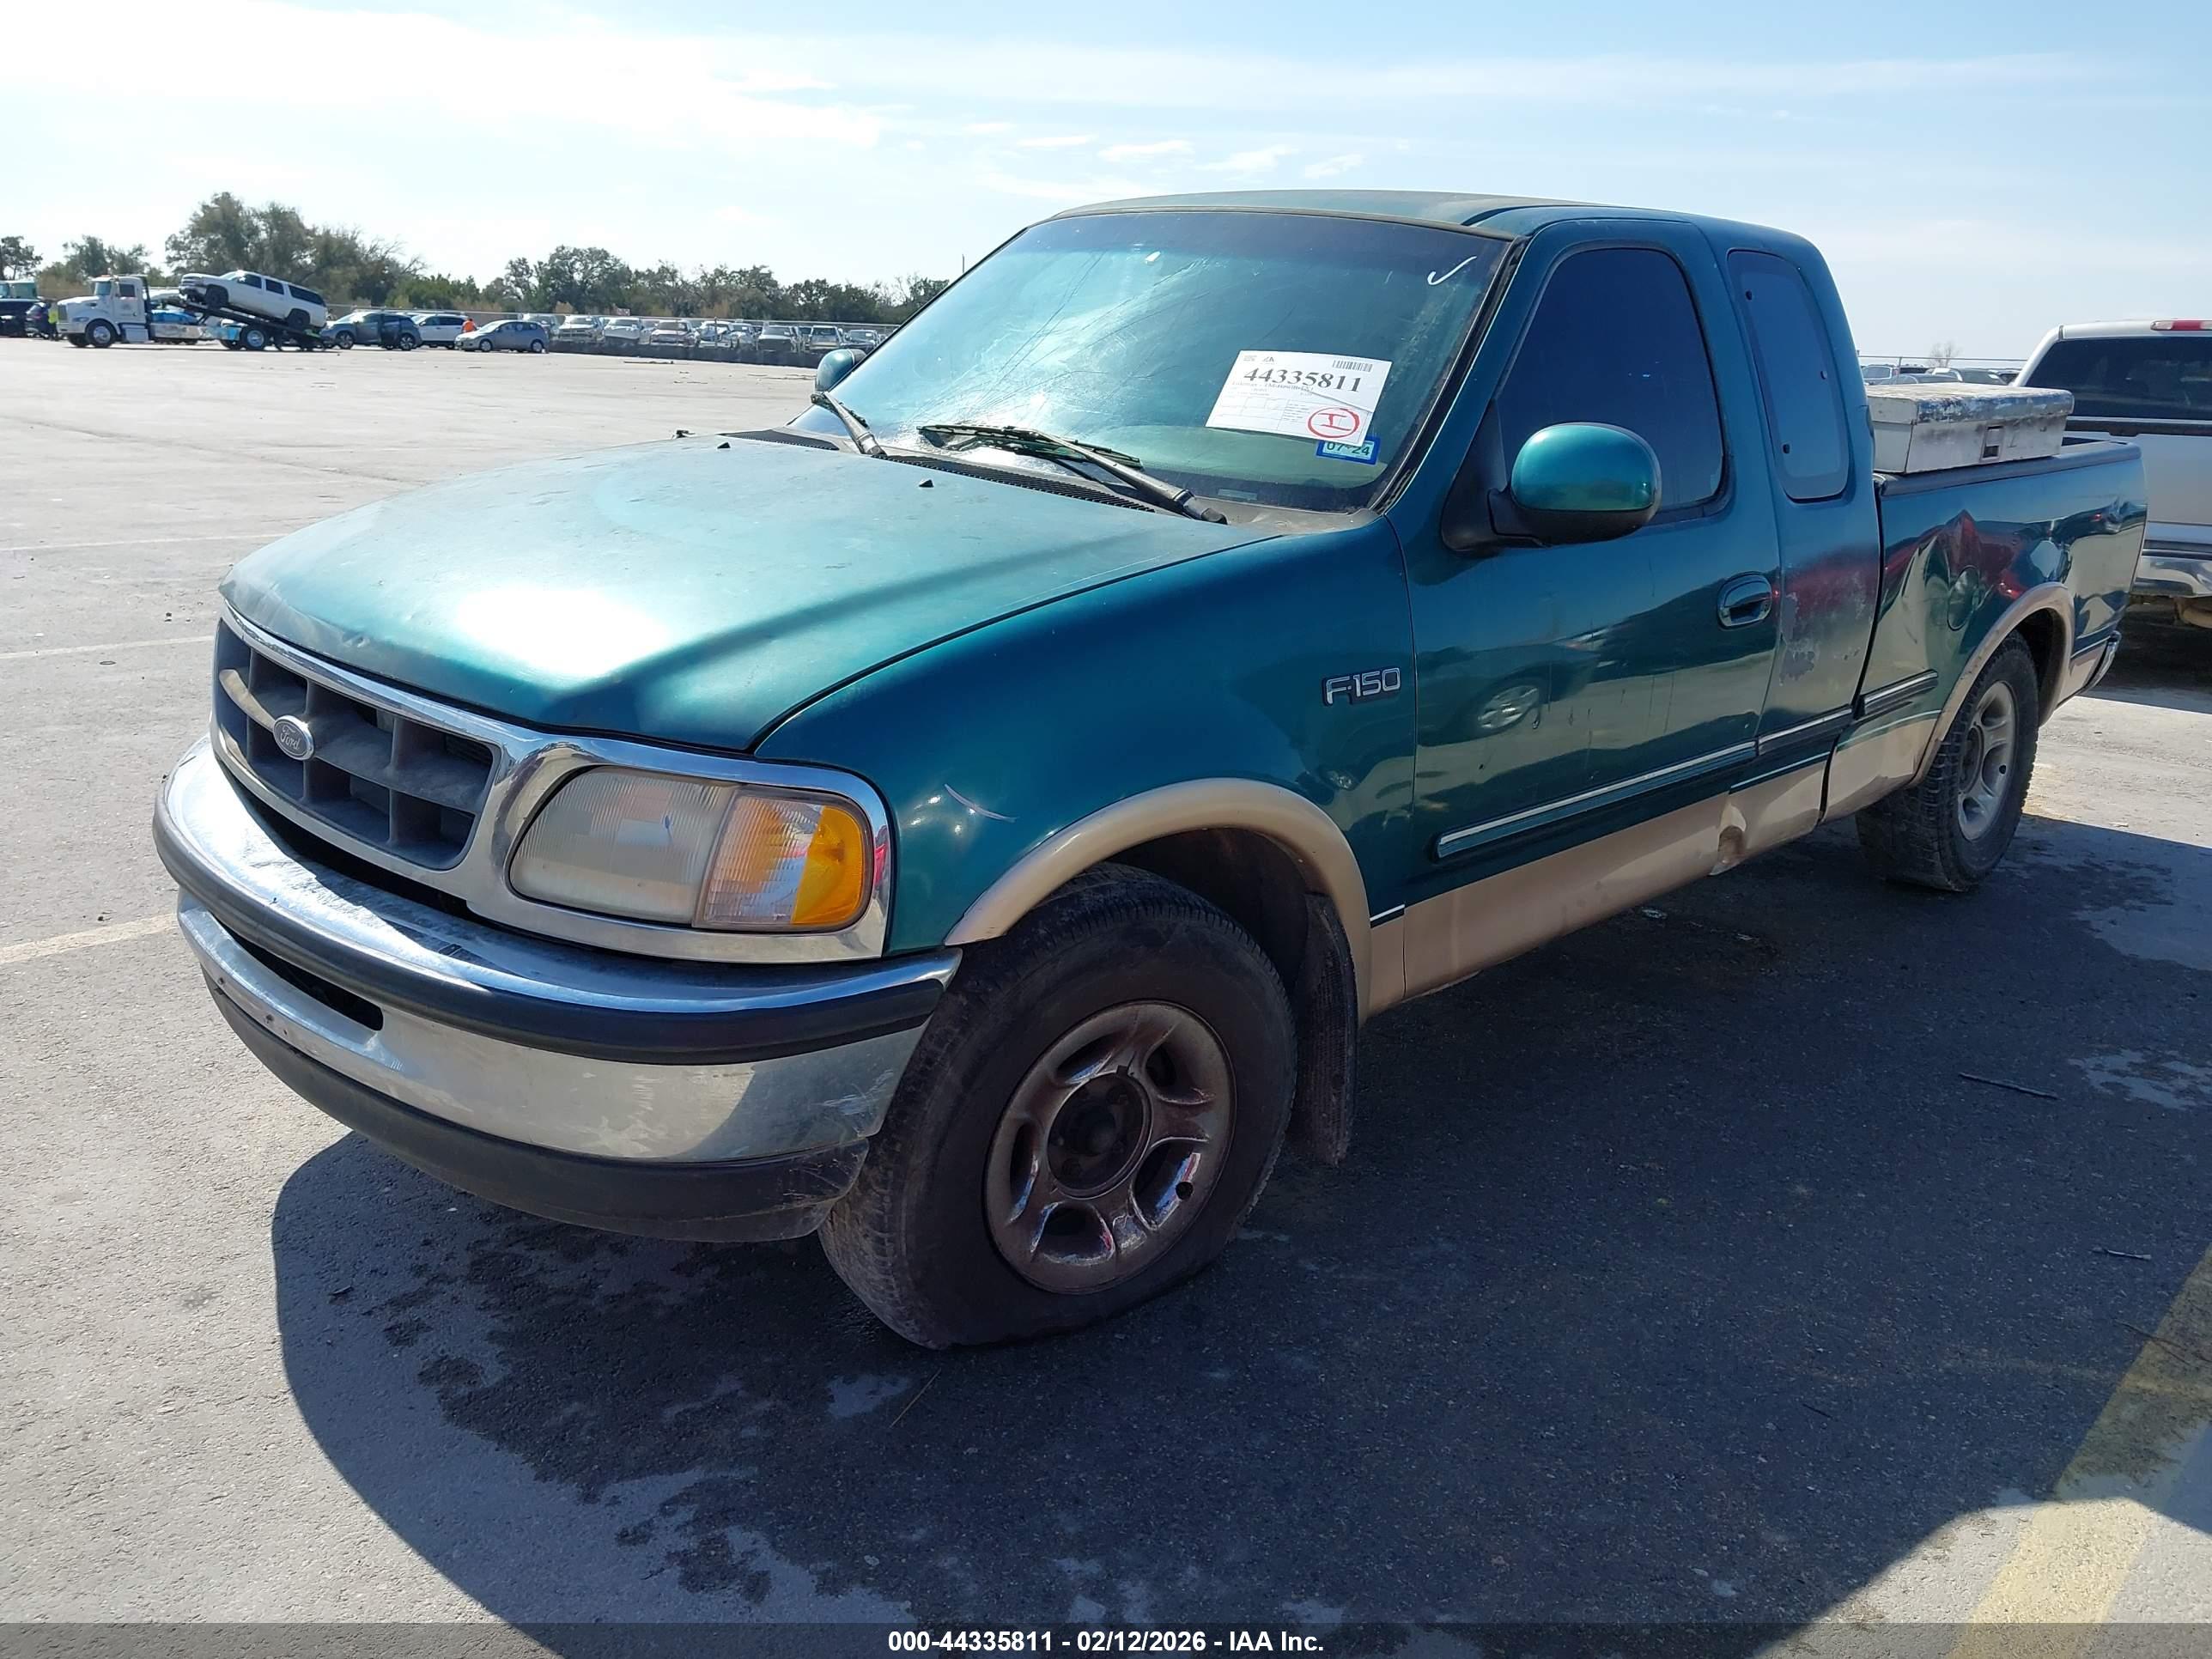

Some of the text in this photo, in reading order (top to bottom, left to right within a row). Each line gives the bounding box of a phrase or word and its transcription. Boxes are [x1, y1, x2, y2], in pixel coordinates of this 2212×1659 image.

[1243, 368, 1362, 392] 44335811
[1327, 441, 1370, 456] 07 24
[280, 724, 301, 750] Ford
